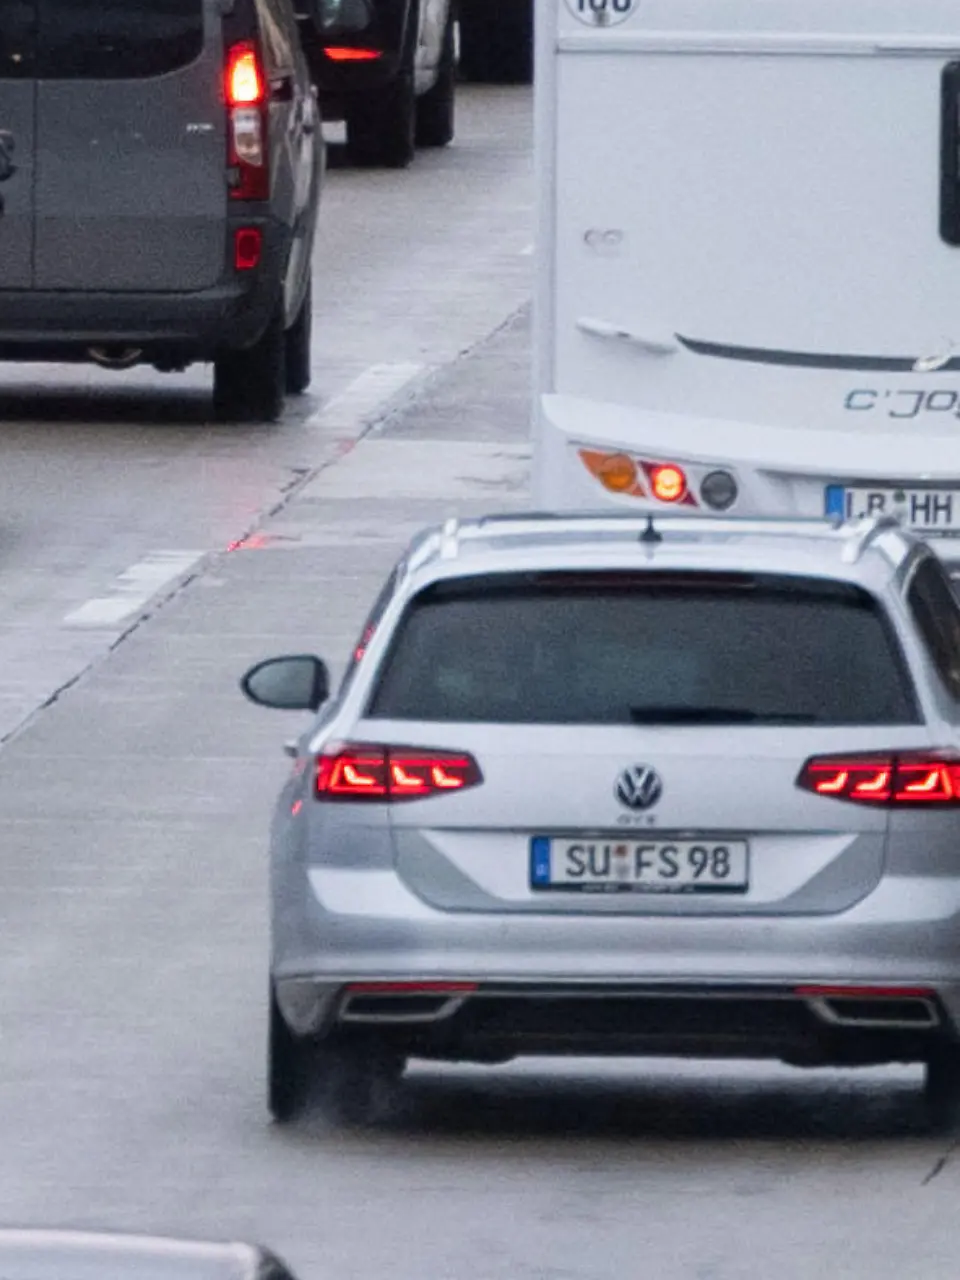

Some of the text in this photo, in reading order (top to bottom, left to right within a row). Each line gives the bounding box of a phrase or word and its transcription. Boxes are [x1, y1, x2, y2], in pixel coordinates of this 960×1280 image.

[910, 493, 952, 523] HH
[565, 845, 610, 878] SU
[634, 845, 680, 879] FS
[688, 845, 731, 879] 98
